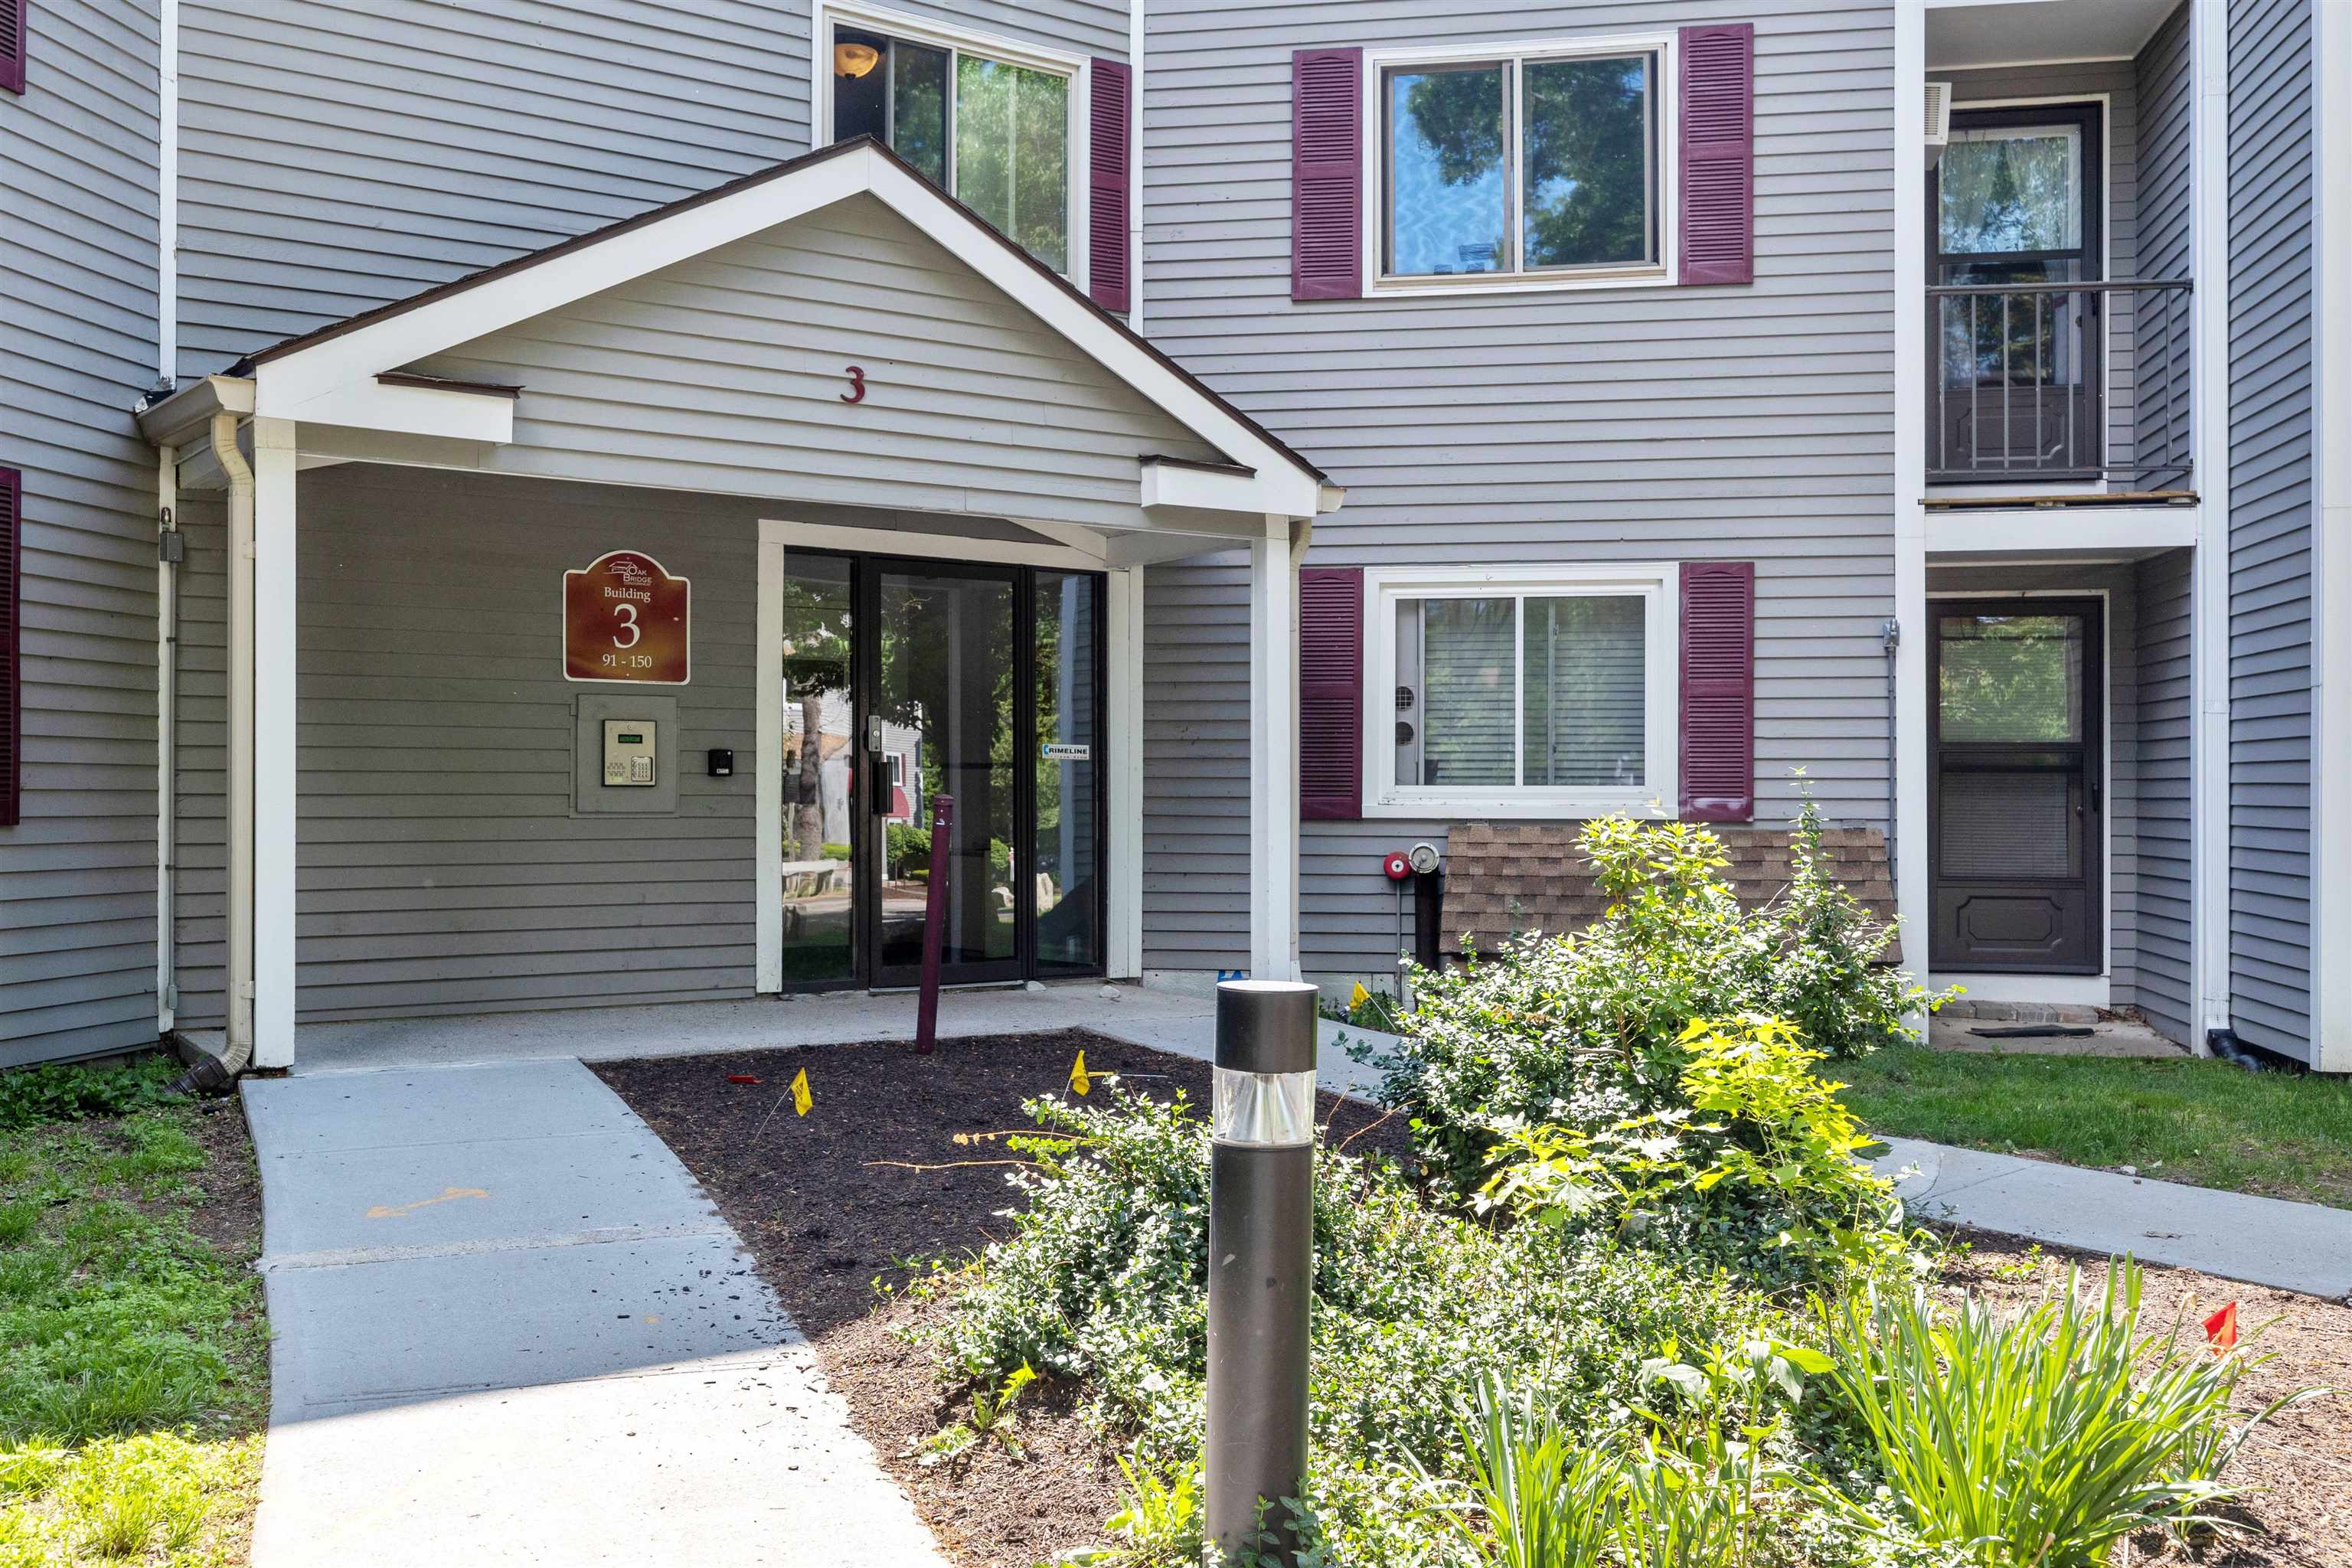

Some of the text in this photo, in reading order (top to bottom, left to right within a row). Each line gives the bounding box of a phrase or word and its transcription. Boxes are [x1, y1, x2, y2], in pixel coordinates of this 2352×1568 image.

[840, 366, 865, 403] 3
[604, 586, 651, 603] Building
[612, 603, 640, 648] 3
[603, 654, 616, 666] 91
[631, 655, 652, 668] 150
